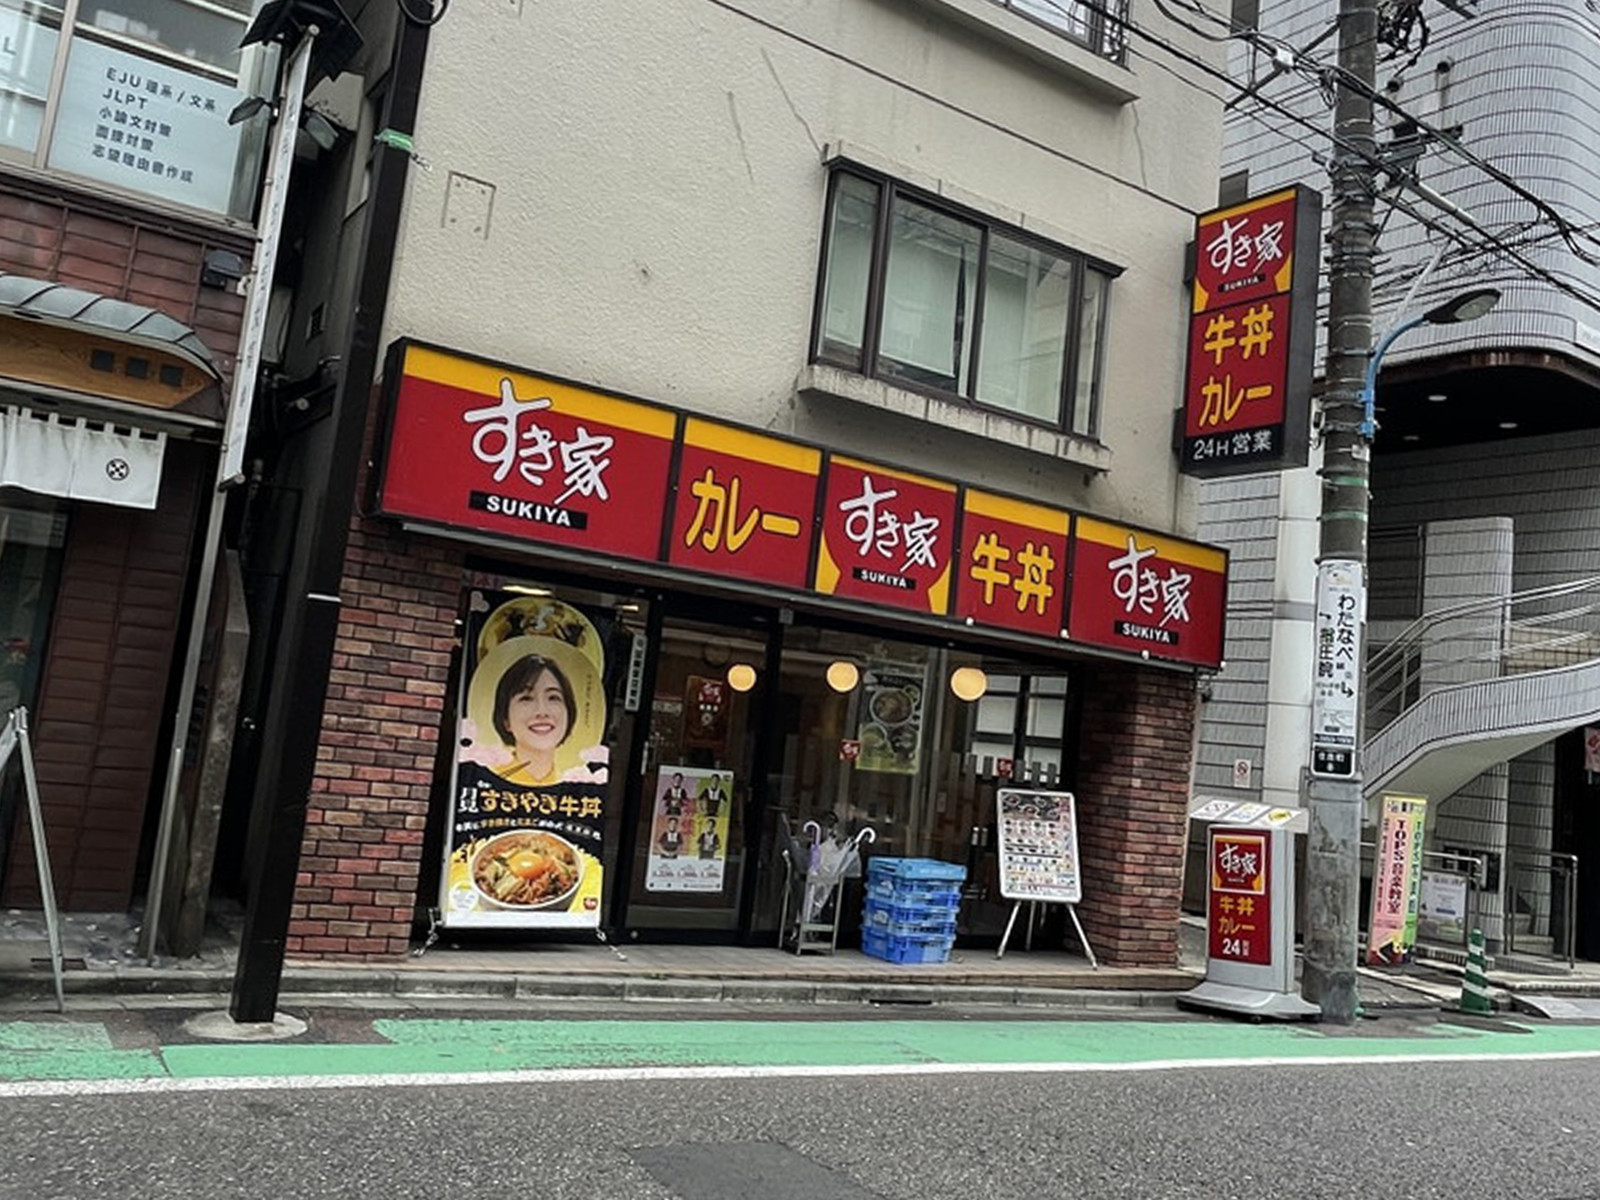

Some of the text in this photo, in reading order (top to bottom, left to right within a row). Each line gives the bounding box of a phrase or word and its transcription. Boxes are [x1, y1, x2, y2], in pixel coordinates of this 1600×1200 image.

[106, 67, 141, 88] EJU
[102, 88, 148, 109] JLPT
[1206, 218, 1284, 274] すき家
[1204, 303, 1274, 365] 牛丼
[1199, 374, 1272, 427] カレー
[464, 378, 614, 505] すき家
[1193, 429, 1272, 460] 24H営業
[486, 494, 571, 527] SUKIYA
[685, 468, 800, 553] カレー
[839, 475, 940, 573] すき家
[861, 569, 907, 589] SUKIYA
[970, 532, 1056, 615] 牛丼
[1108, 534, 1192, 627] すき家
[1122, 621, 1171, 644] SUKIYA
[1219, 844, 1257, 877] すき家
[1219, 896, 1255, 916] 牛丼
[1218, 917, 1255, 934] カレー
